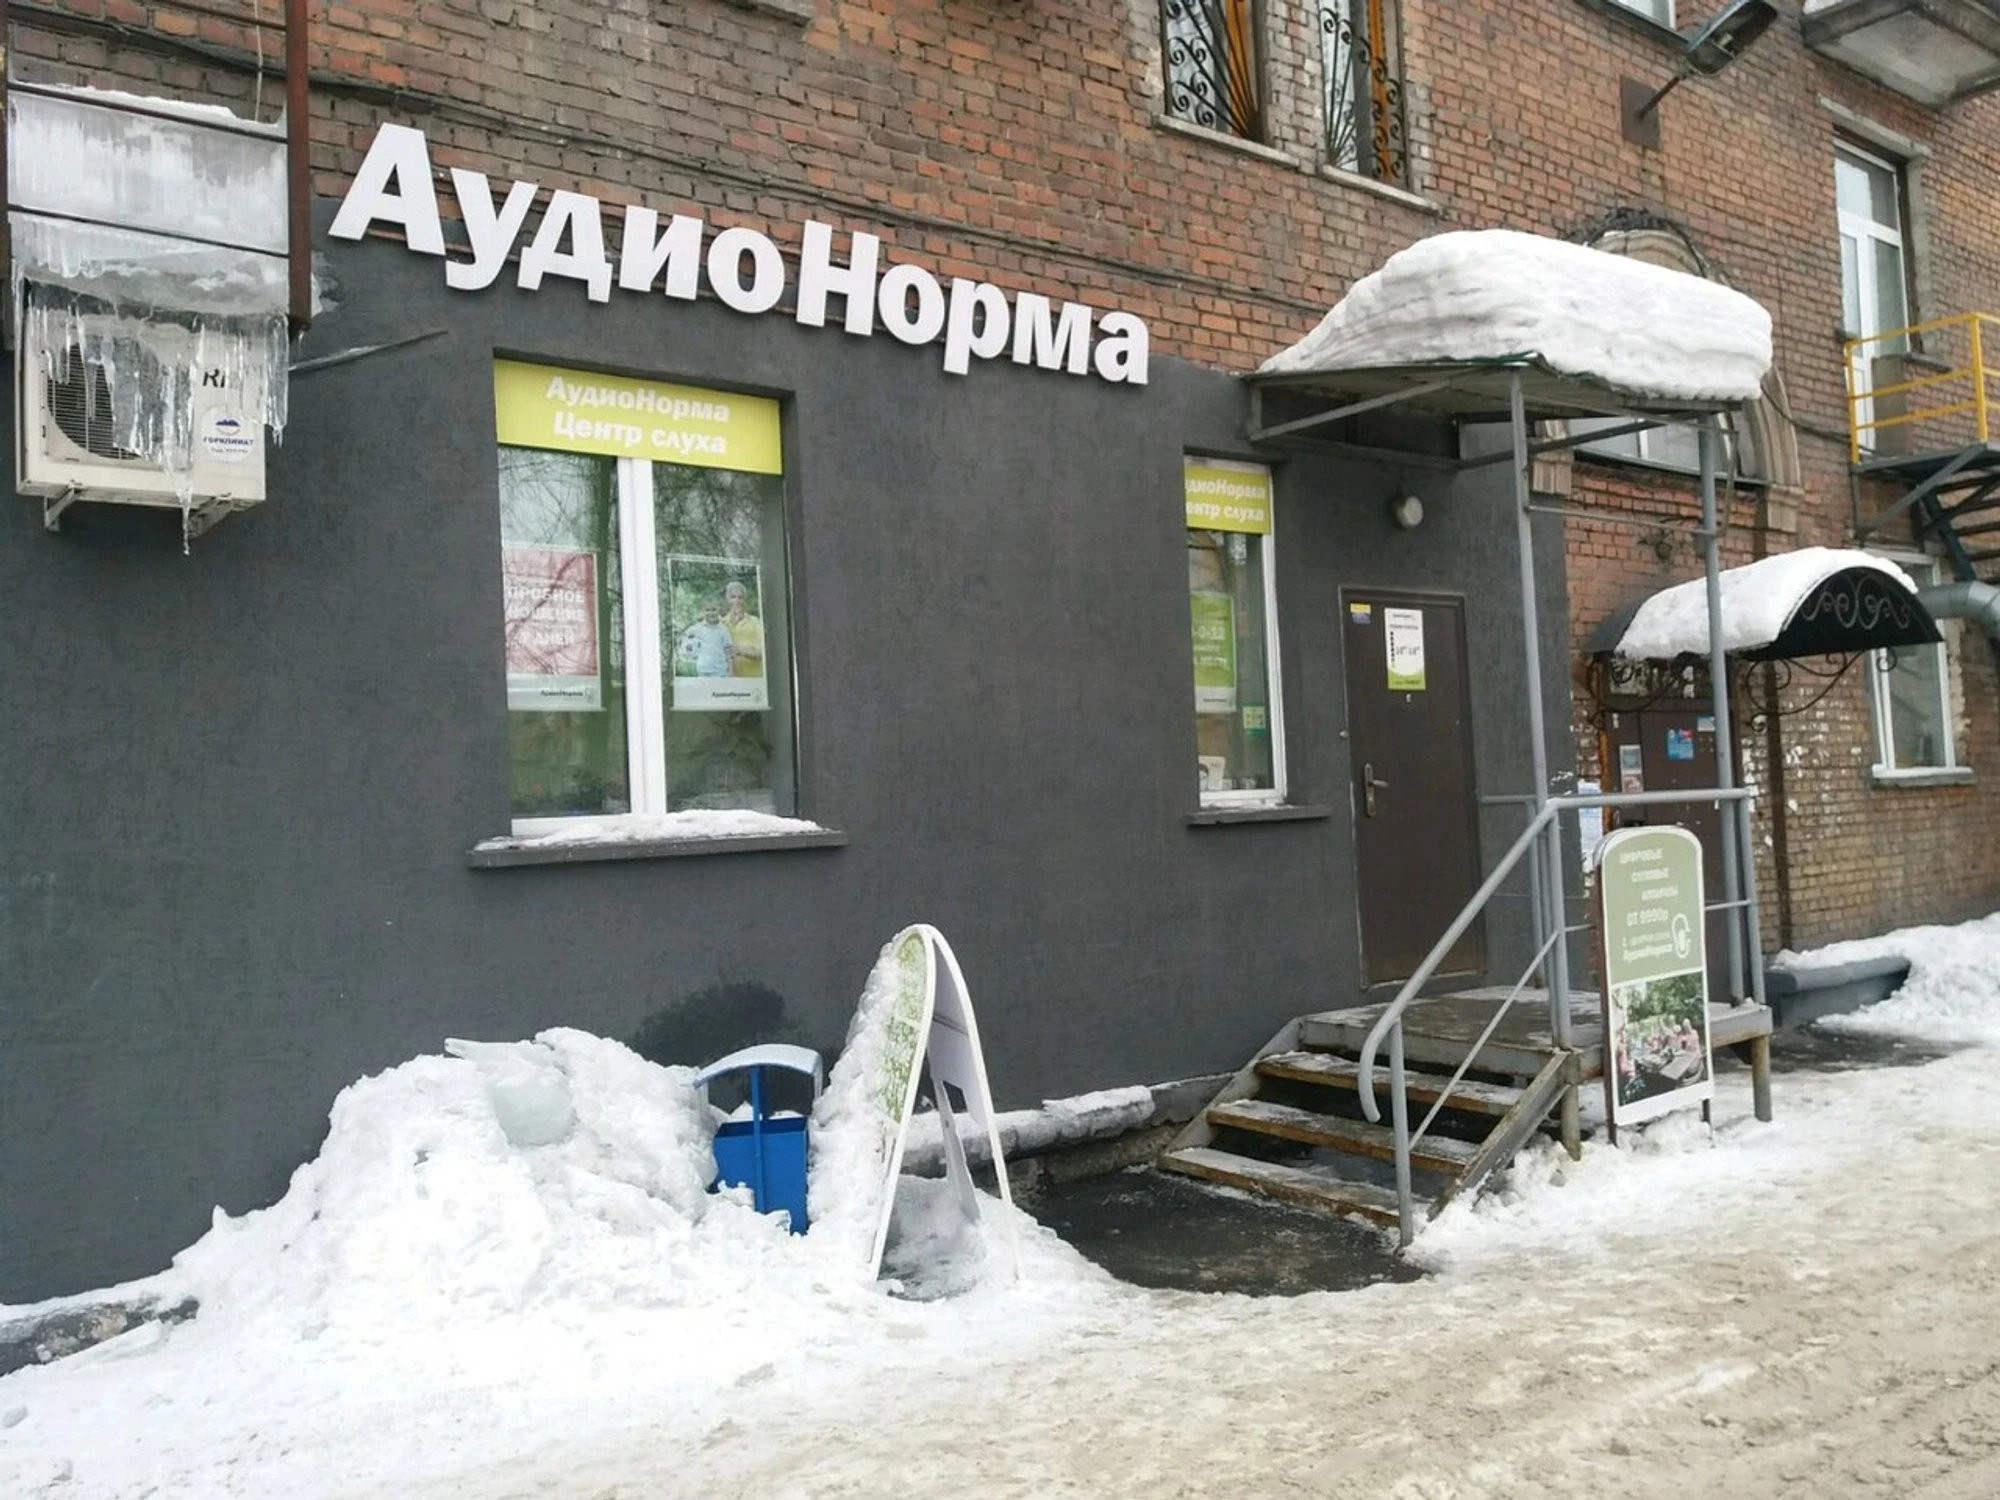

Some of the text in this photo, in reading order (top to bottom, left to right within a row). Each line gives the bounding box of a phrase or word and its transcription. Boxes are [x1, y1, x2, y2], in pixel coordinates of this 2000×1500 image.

[328, 122, 1150, 385] АудиоНорма
[546, 375, 730, 422] АудиоНорма
[553, 411, 727, 455] Центр слуха
[1224, 505, 1265, 523] слуха
[507, 585, 585, 603] ПРОБНОЕ
